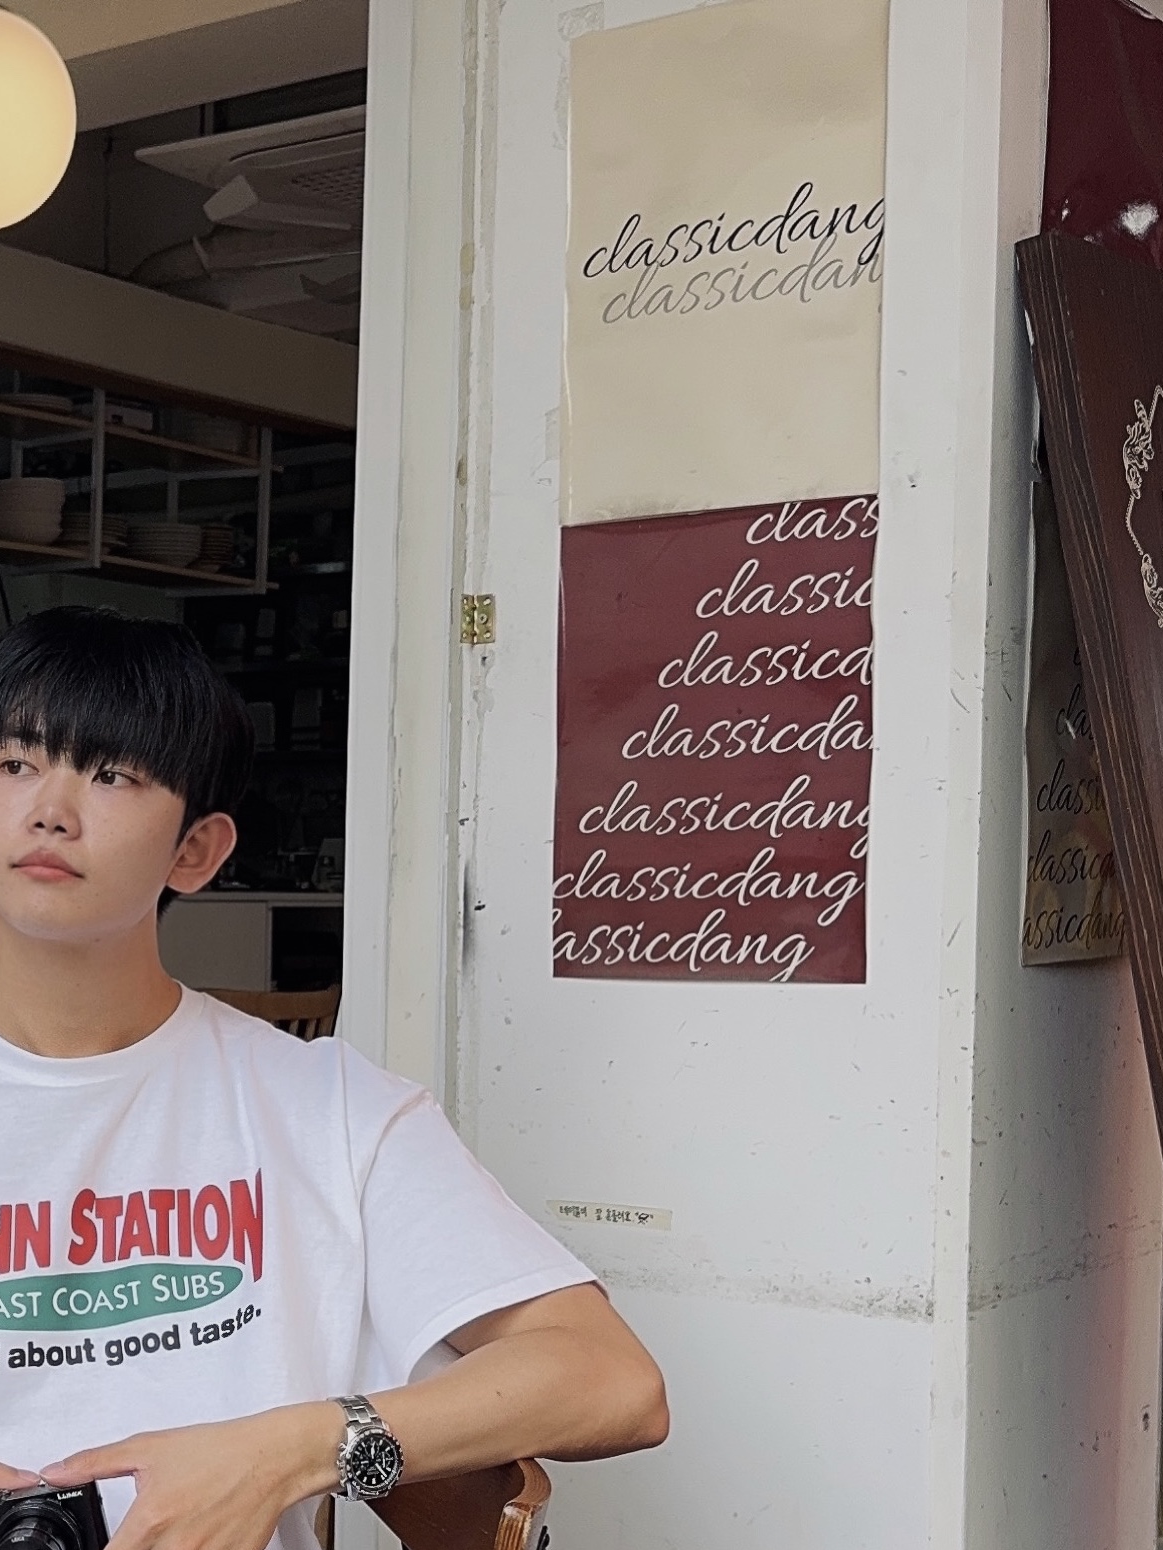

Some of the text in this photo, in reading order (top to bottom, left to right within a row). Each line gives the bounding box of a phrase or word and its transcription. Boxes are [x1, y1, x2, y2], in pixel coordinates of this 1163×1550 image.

[583, 182, 884, 278] classicdang
[602, 232, 882, 324] classicdan
[622, 694, 874, 761] classicda
[553, 847, 865, 926] classicdang
[67, 1168, 262, 1282] STATION
[52, 1280, 141, 1316] COAST
[151, 1270, 225, 1303] SUBS
[7, 1337, 97, 1369] about
[104, 1323, 181, 1366] good
[189, 1304, 263, 1347] taste.
